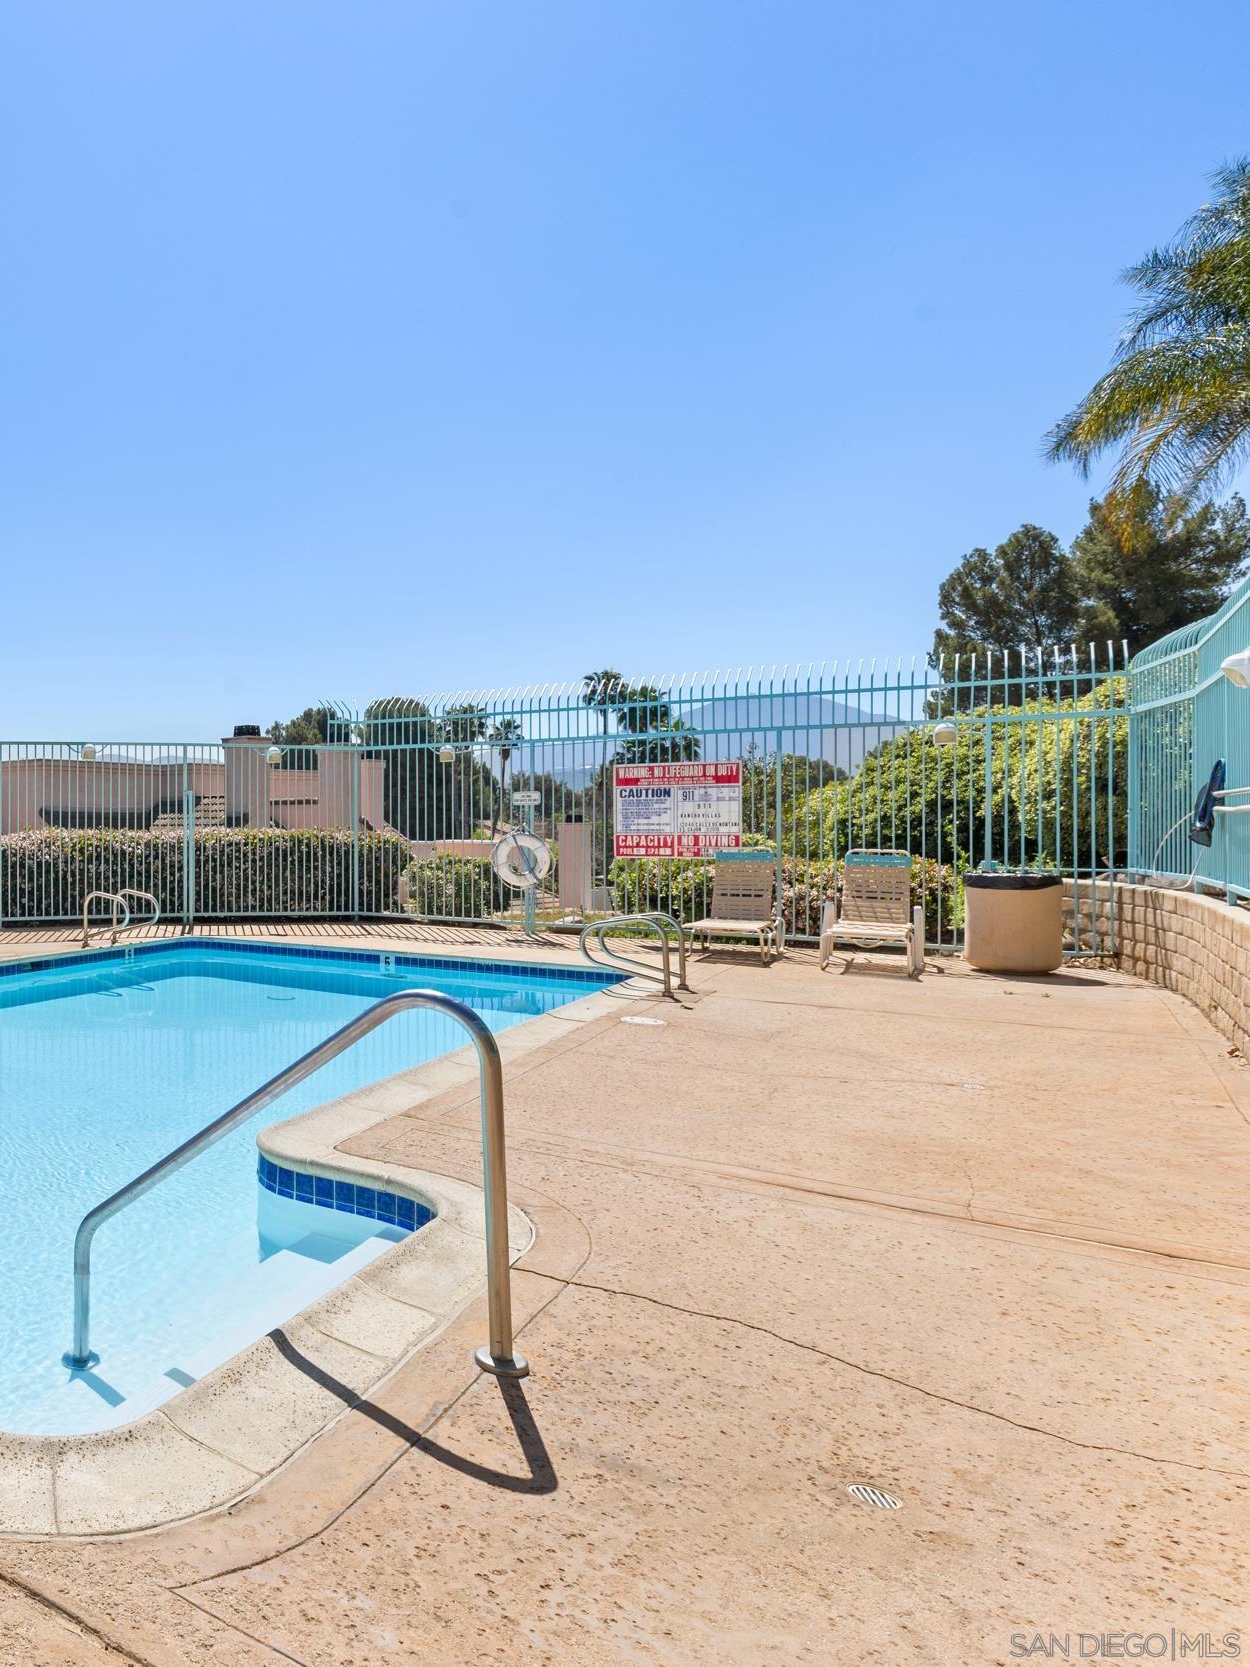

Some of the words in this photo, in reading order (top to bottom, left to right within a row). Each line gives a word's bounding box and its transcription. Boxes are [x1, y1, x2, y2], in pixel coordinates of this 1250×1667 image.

[619, 766, 652, 778] WARNING:
[654, 766, 664, 778] NO
[665, 765, 703, 777] LIFEGUARD
[705, 764, 715, 776] ON
[717, 763, 737, 776] DUTY
[619, 787, 671, 798] CAUTION
[682, 791, 695, 801] 911
[619, 835, 673, 847] CAPACITY
[681, 835, 695, 847] NO
[699, 835, 736, 847] DIVING
[619, 847, 634, 855] POOL
[647, 847, 659, 855] SPA
